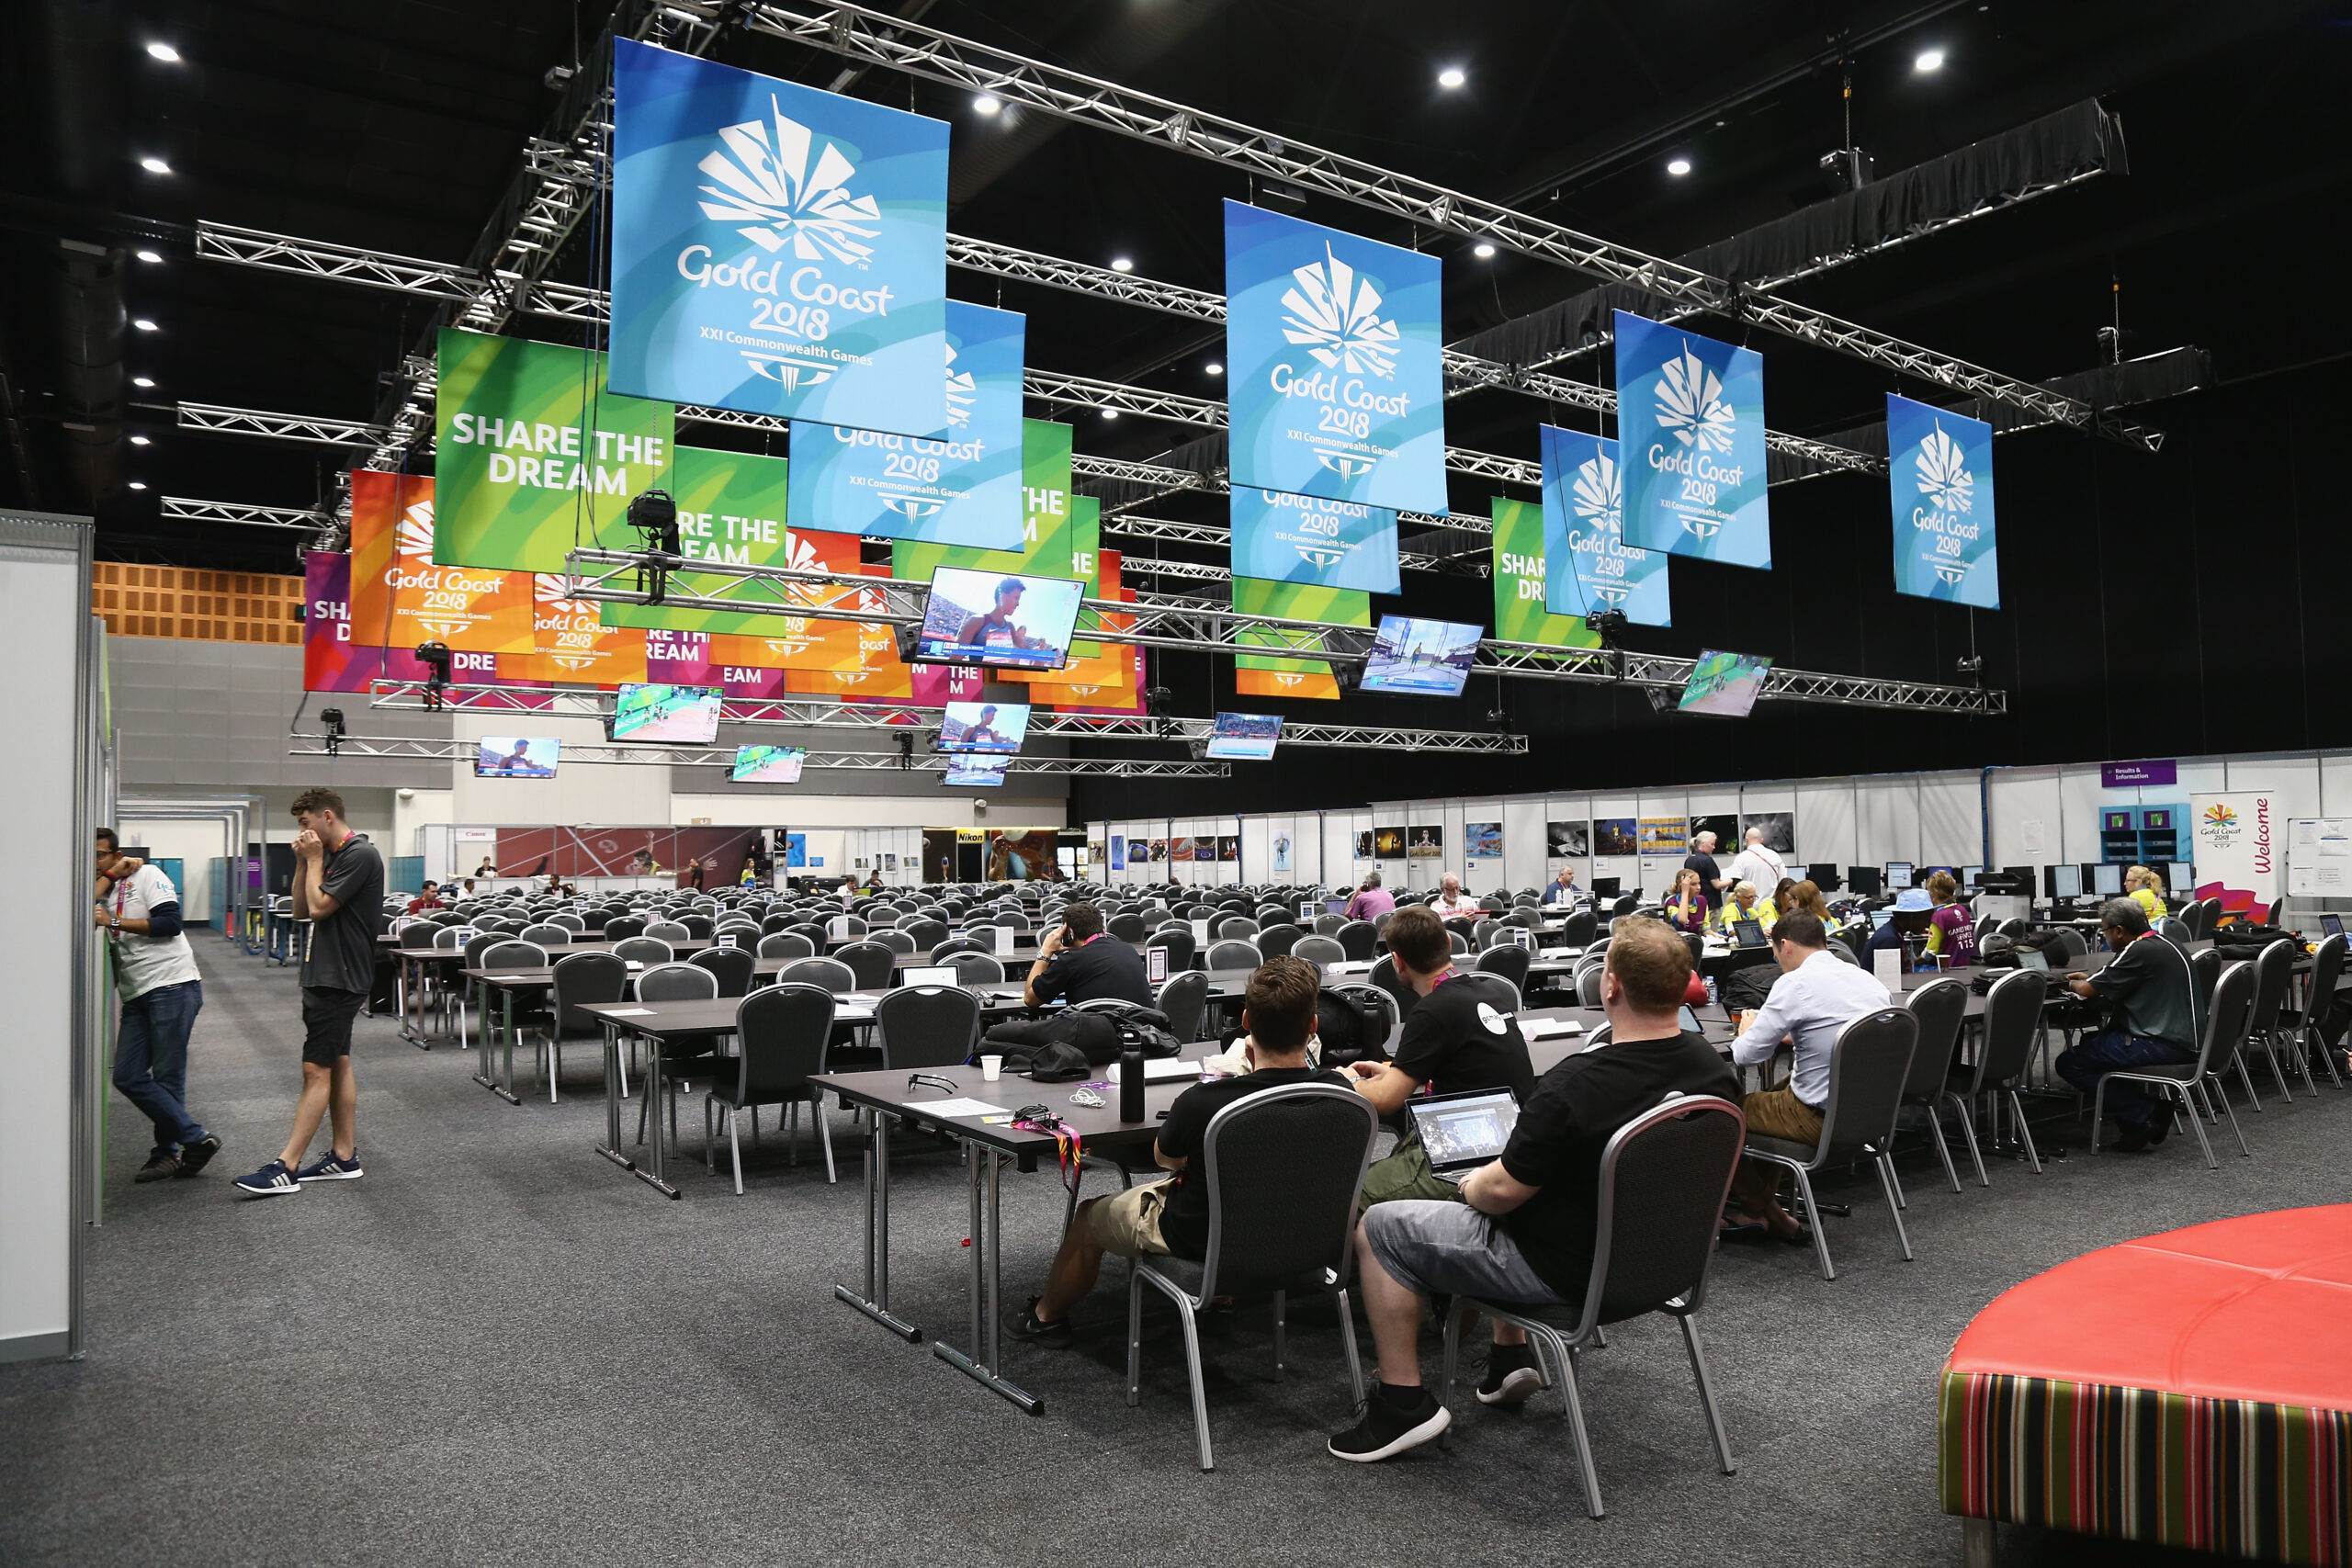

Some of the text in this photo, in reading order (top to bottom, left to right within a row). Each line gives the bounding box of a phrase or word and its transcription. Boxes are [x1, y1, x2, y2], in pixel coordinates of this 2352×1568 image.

[677, 244, 895, 316] Gold Coast
[750, 298, 830, 341] 2018
[699, 326, 873, 366] XXI Commonwealth Games
[1271, 364, 1410, 418] Gold Coast
[1318, 405, 1370, 439] 2018
[452, 412, 663, 467] SHARE THE
[911, 437, 985, 462] Coast
[1287, 429, 1398, 457] XXI Commonwealth Games
[489, 453, 627, 496] DREAM
[883, 453, 940, 483] 2018
[1648, 444, 1744, 487] Gold Coast
[849, 475, 970, 499] XXI Commonwealth Games
[1681, 478, 1716, 505] 2018
[721, 515, 777, 544] THE
[1299, 512, 1340, 537] 2018
[1913, 507, 1979, 540] Gold Coast
[1288, 534, 1339, 547] Commonwealth
[1340, 541, 1362, 550] Games
[1569, 529, 1646, 561] Gold Coast
[1936, 535, 1961, 558] 2018
[1501, 552, 1545, 578] SHAR
[1595, 557, 1624, 577] 2018
[385, 568, 504, 594] Gold Coast
[423, 591, 468, 610] 2018
[411, 609, 467, 619] Commonwealth
[467, 613, 492, 621] Games
[556, 632, 592, 649] 2018
[646, 643, 699, 661] REAM
[859, 638, 890, 652] oast
[454, 652, 497, 671] DRE
[949, 665, 978, 680] THE
[724, 667, 762, 683] EAM
[958, 832, 983, 841] Nikon
[2200, 828, 2220, 836] Gold
[2254, 798, 2271, 874] Welcome
